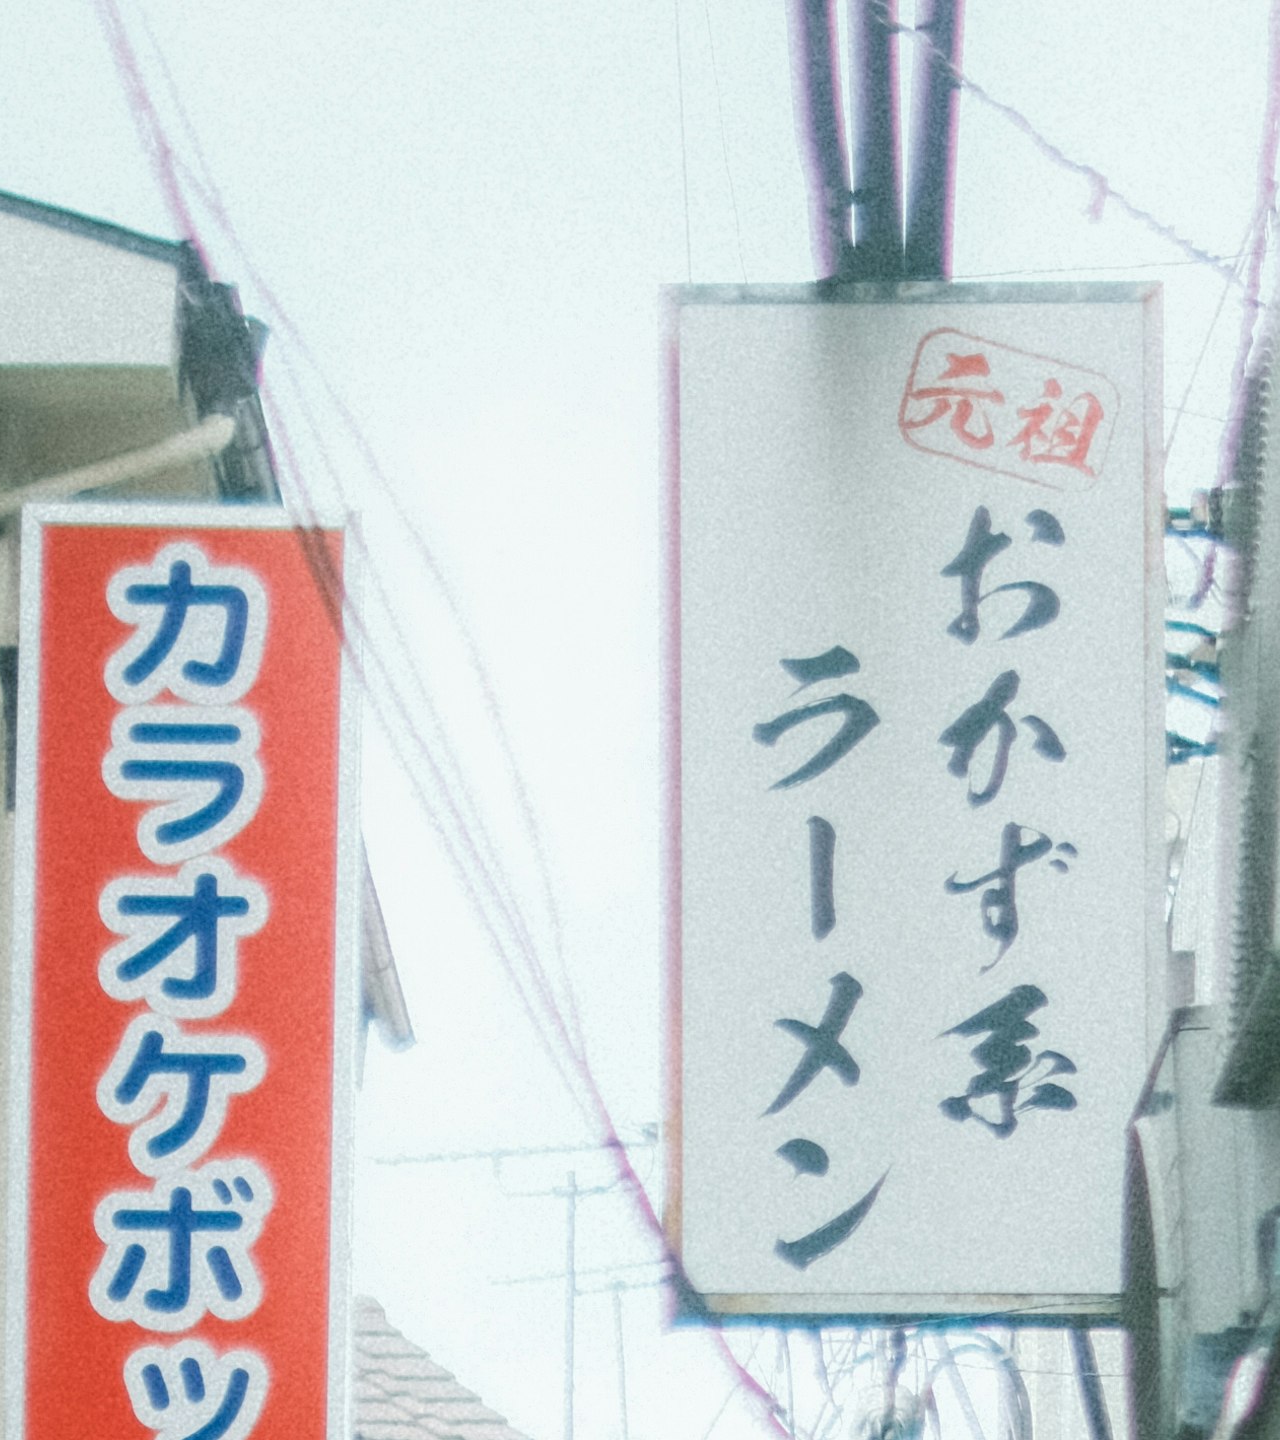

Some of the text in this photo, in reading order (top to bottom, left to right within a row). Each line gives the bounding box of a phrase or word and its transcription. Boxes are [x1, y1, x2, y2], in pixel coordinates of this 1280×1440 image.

[906, 351, 1099, 479] 元祖
[752, 644, 893, 1271] ラーメン
